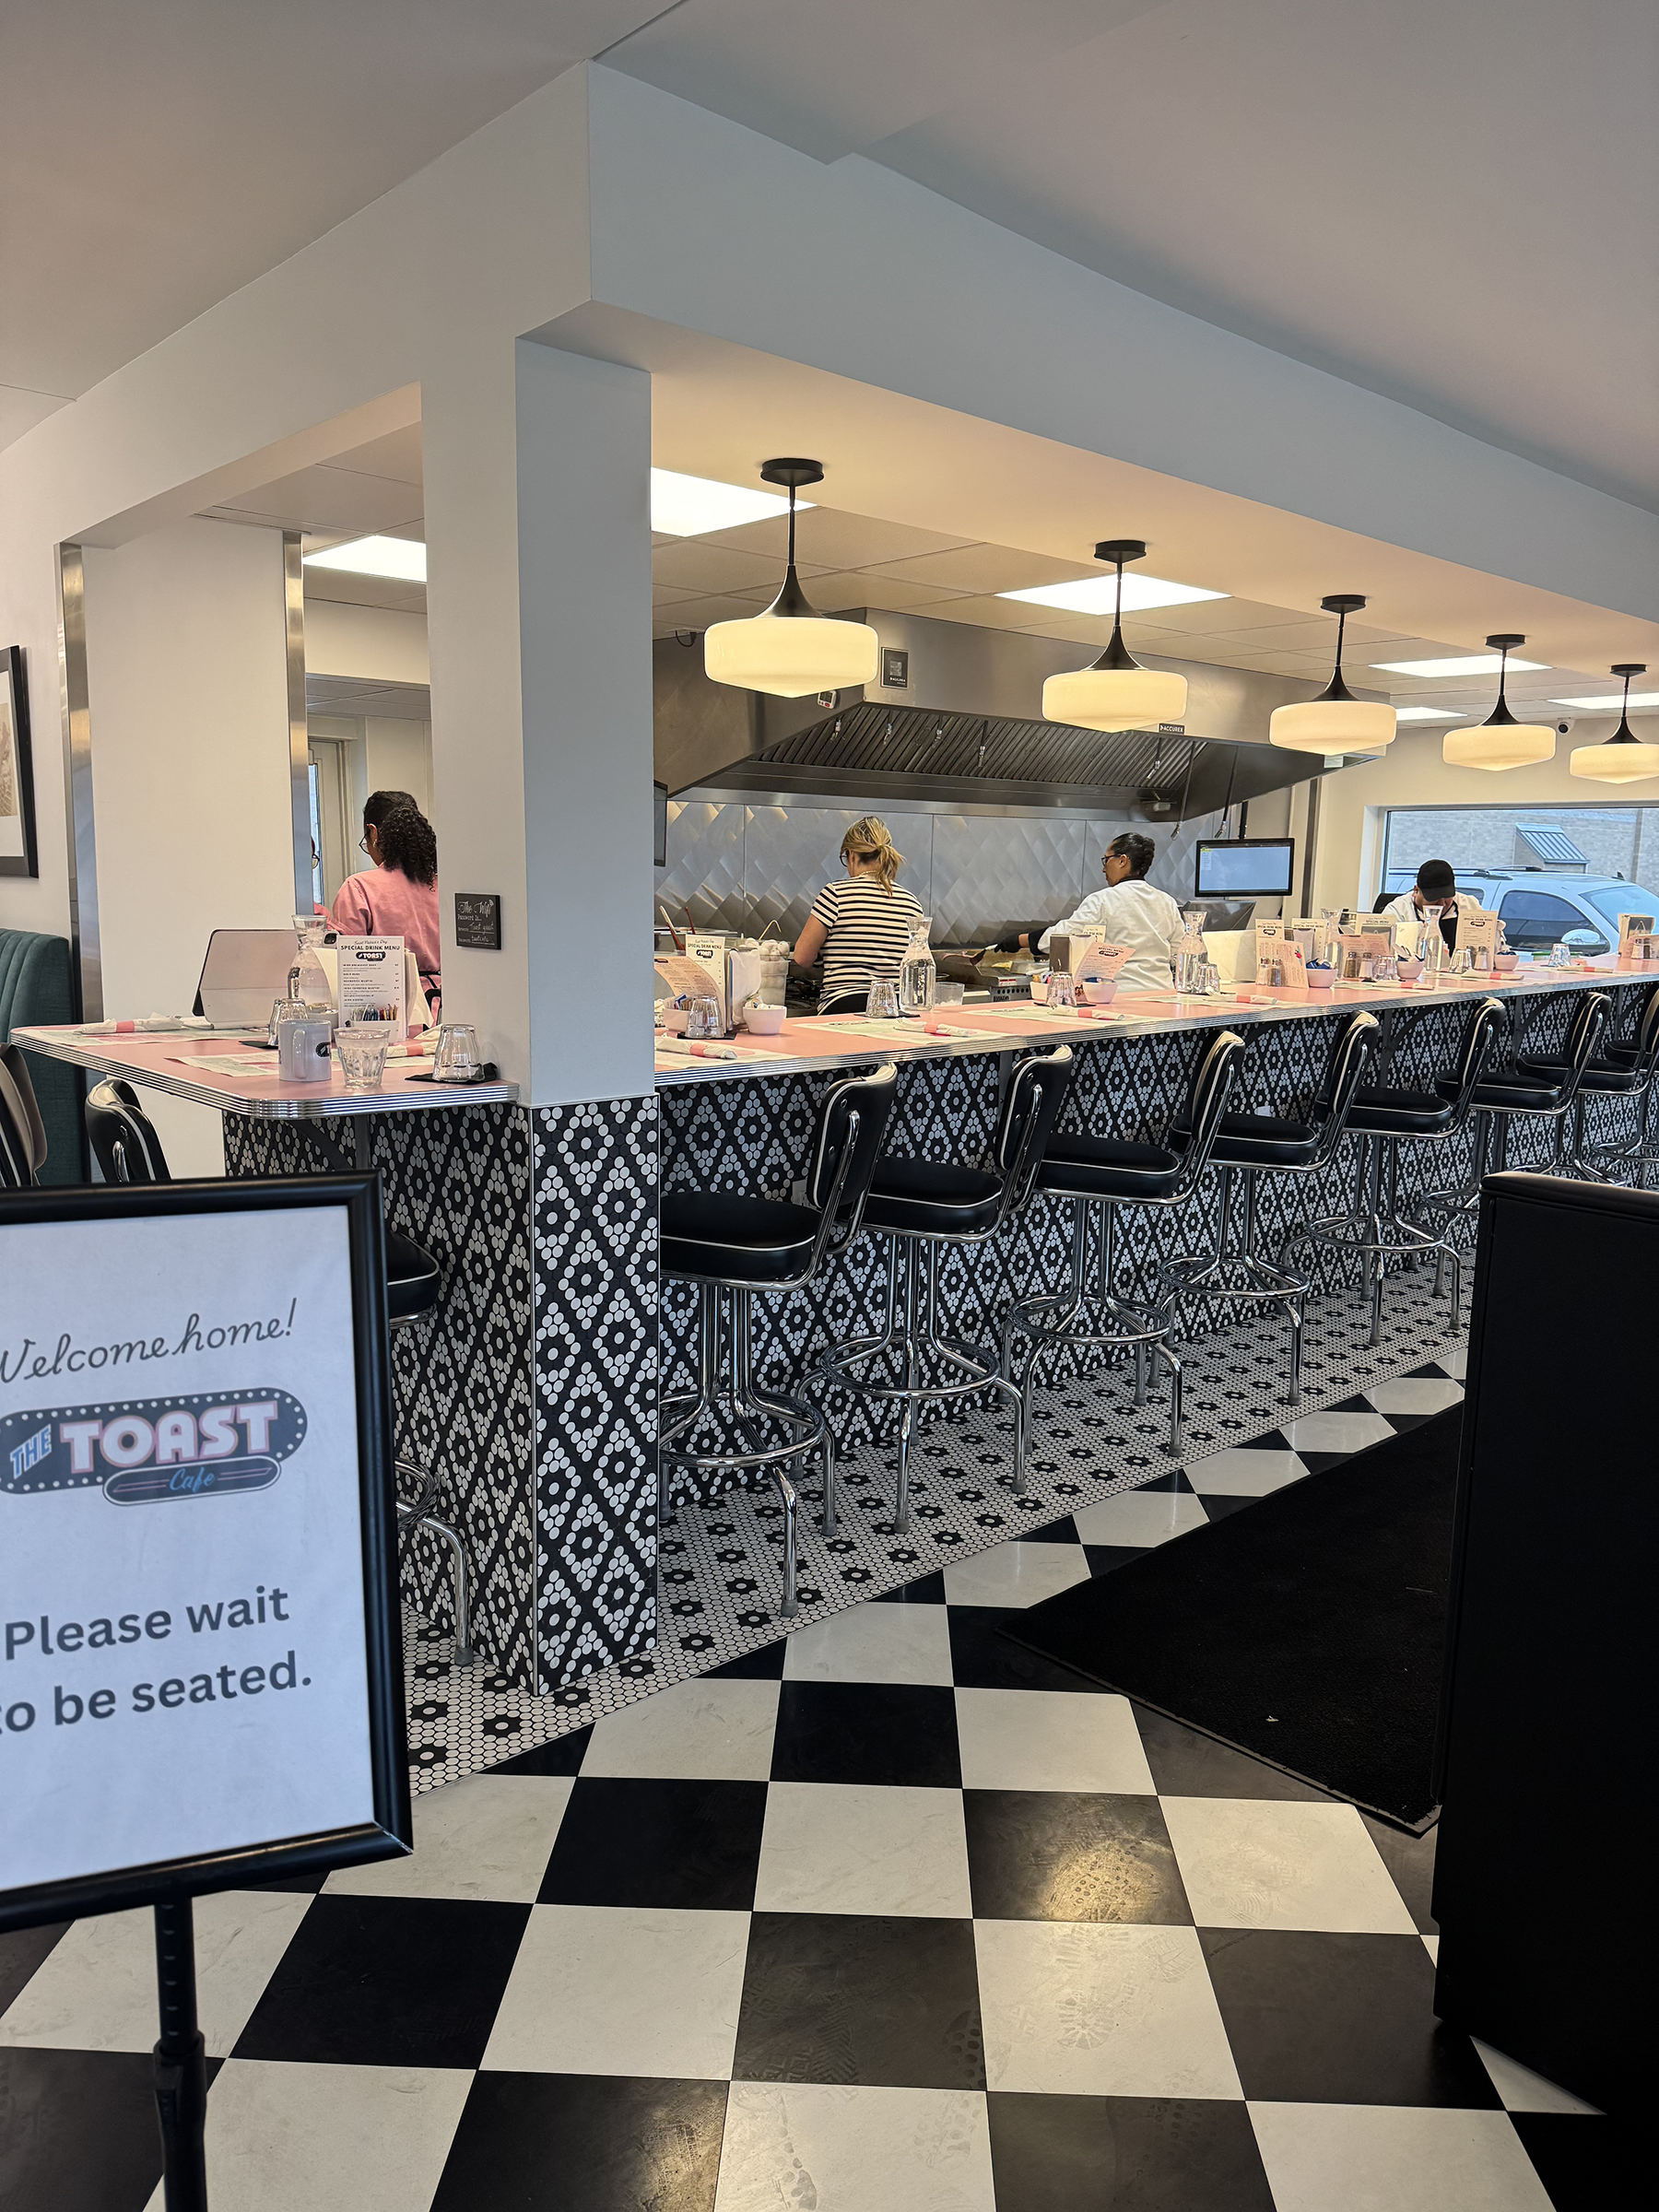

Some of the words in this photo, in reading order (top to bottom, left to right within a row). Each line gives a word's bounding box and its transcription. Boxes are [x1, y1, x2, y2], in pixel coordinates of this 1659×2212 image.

[457, 900, 472, 913] The
[171, 1297, 298, 1356] home!
[9, 1423, 53, 1480] THE
[59, 1400, 279, 1475] TOAST
[169, 1466, 217, 1493] Cafe
[5, 1609, 172, 1660] Please
[185, 1584, 289, 1633] wait
[0, 1700, 36, 1735] o
[53, 1685, 116, 1726] be
[131, 1650, 312, 1712] seated.
